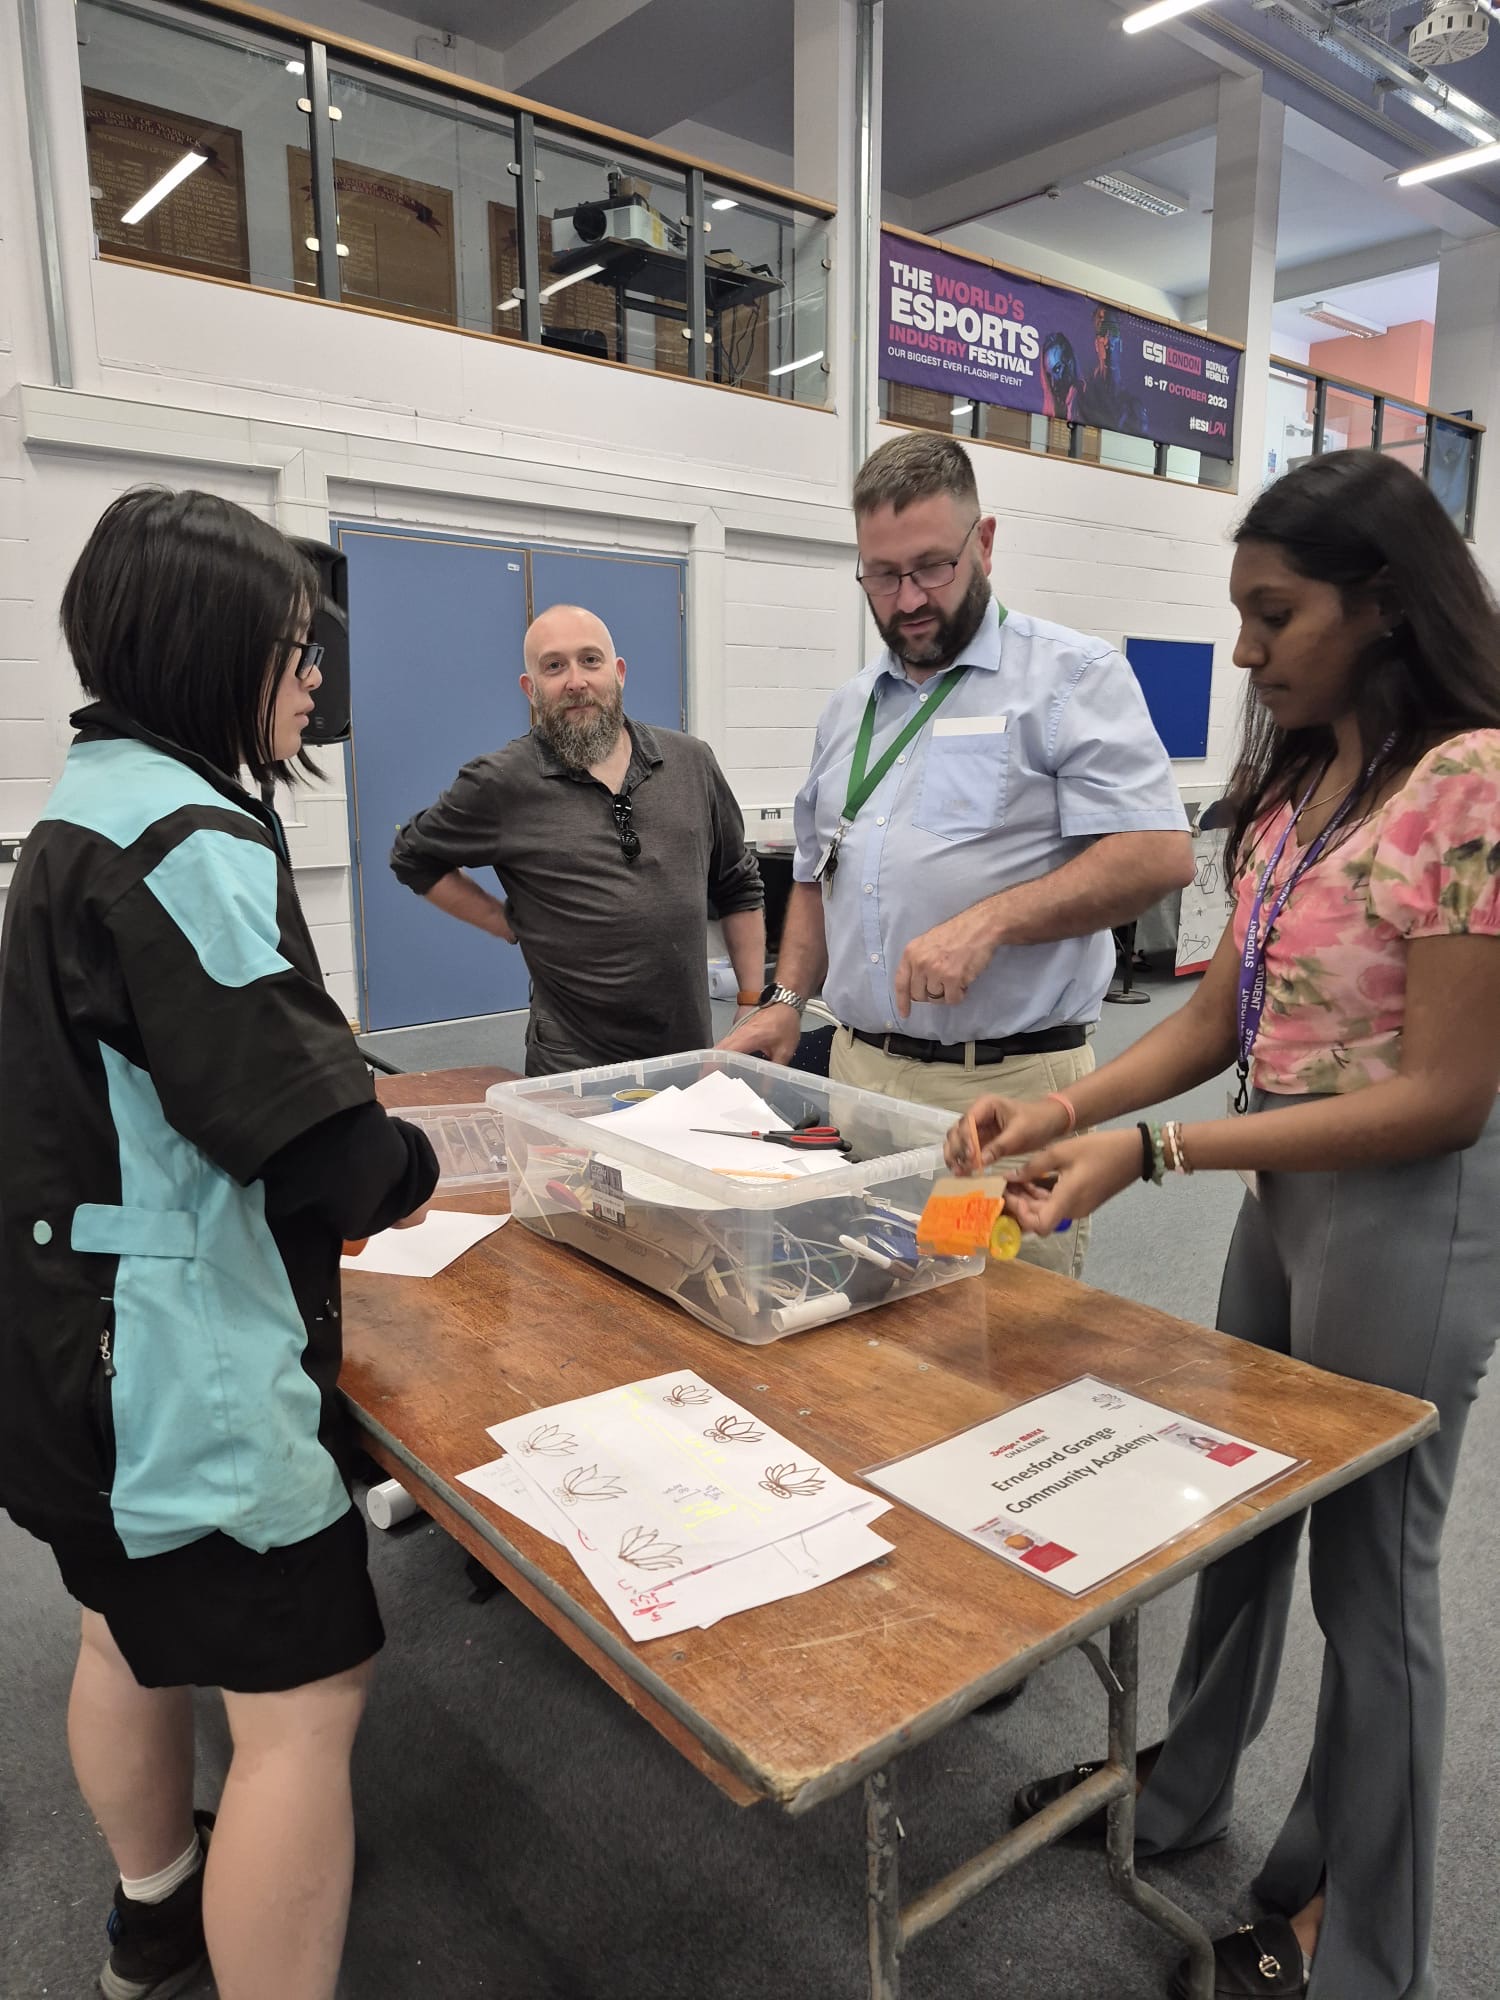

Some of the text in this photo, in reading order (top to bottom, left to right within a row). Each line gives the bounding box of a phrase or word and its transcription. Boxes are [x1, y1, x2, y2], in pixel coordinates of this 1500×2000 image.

[889, 260, 1025, 321] THE WORLD'S
[891, 286, 1040, 360] ESPORTS
[888, 346, 1023, 388] OUR BIGGEST EVER FLAGSHIP EVENT
[889, 324, 1034, 376] INDUSTRY FESTIVAL
[1167, 351, 1200, 373] LONDON
[1168, 382, 1207, 403] OCTOBER
[1207, 394, 1228, 409] 2023
[1205, 369, 1230, 385] WEMBLEY
[1244, 919, 1258, 969] STUDENT
[1250, 963, 1265, 1011] STUDENT
[991, 1426, 1117, 1492] Ernesford Grange
[1004, 1435, 1051, 1459] CHALLENGE
[1005, 1432, 1160, 1514] Community Academy
